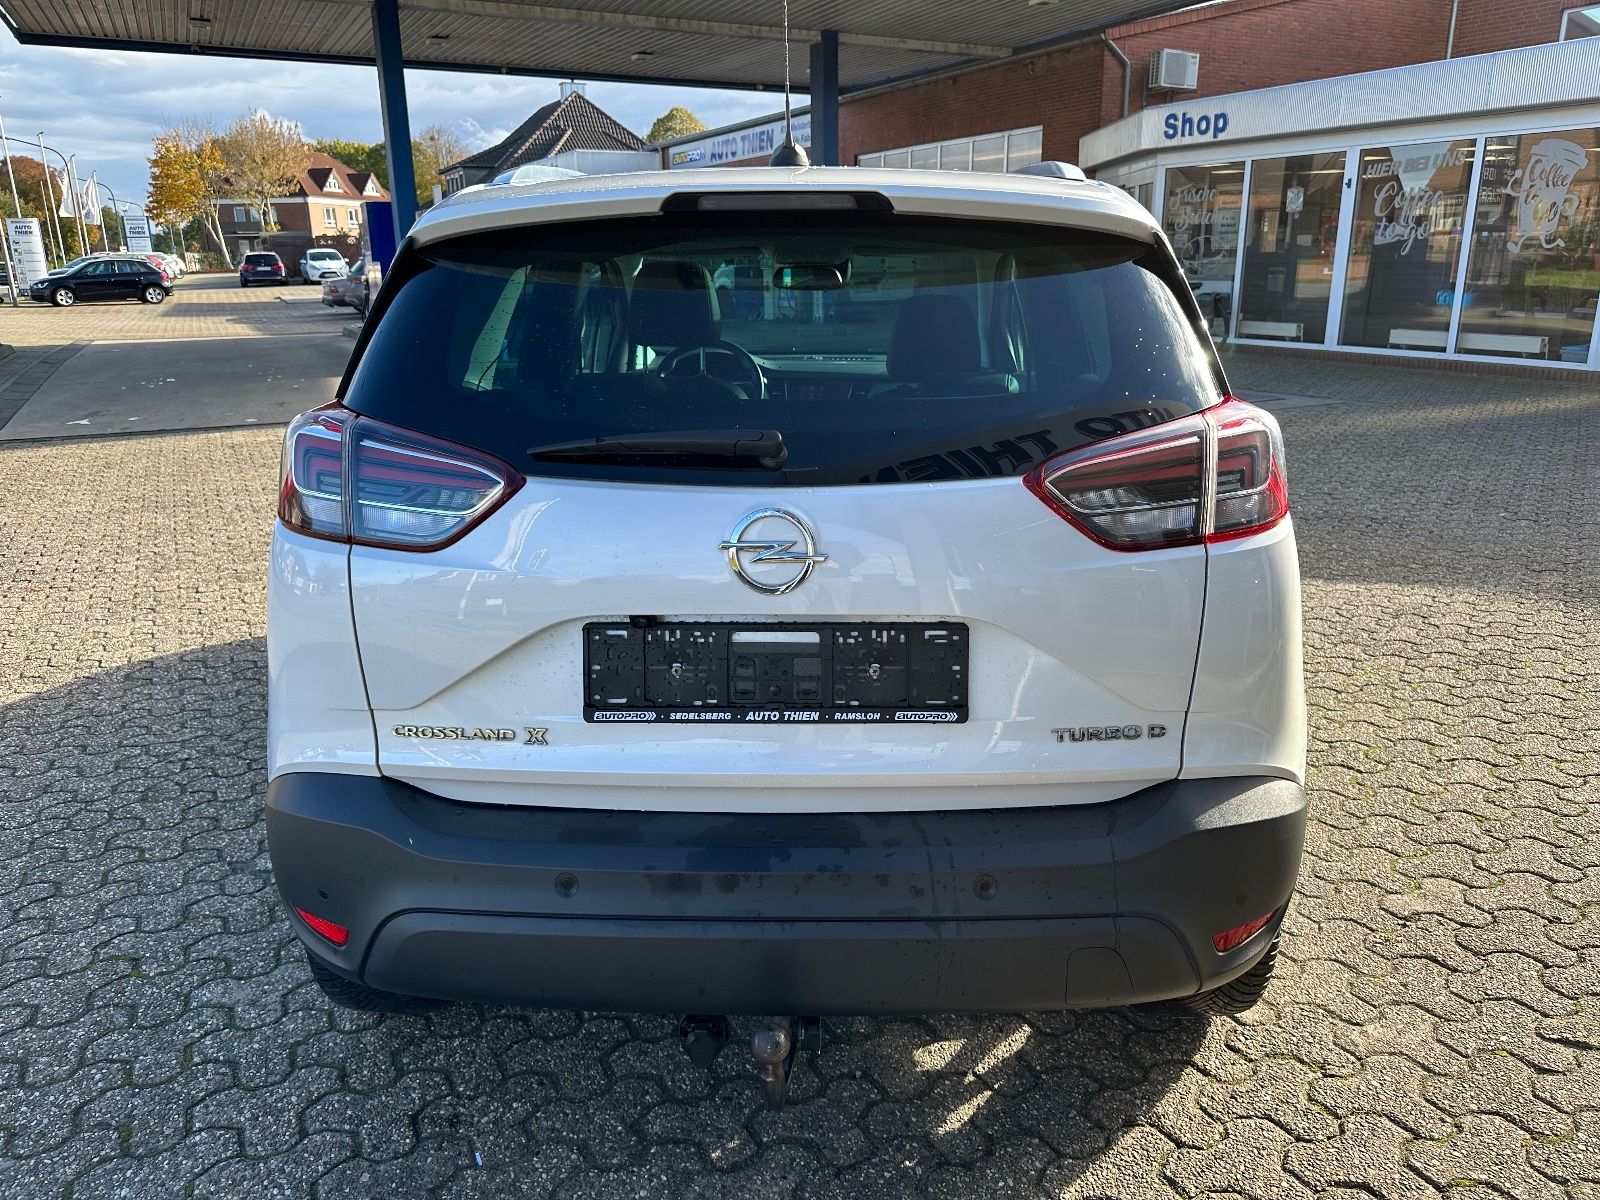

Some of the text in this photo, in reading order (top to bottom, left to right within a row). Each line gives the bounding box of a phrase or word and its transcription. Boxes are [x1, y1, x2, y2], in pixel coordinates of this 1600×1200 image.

[1163, 112, 1229, 140] Shop
[710, 136, 738, 162] AUTO
[741, 128, 774, 156] THIEN
[1366, 160, 1401, 178] HIER
[1402, 155, 1432, 174] BEI
[1432, 150, 1467, 169] UNS
[1528, 158, 1569, 188] Coffee
[1374, 181, 1444, 226] Coffee
[1377, 218, 1430, 255] to go
[669, 712, 732, 720] SEDELSBERG
[745, 711, 780, 721] AUTO
[783, 711, 820, 721] THIEN
[834, 712, 881, 720] RAMSLOH
[391, 724, 549, 746] CROSSLAND X
[1051, 723, 1168, 743] TURBO D
